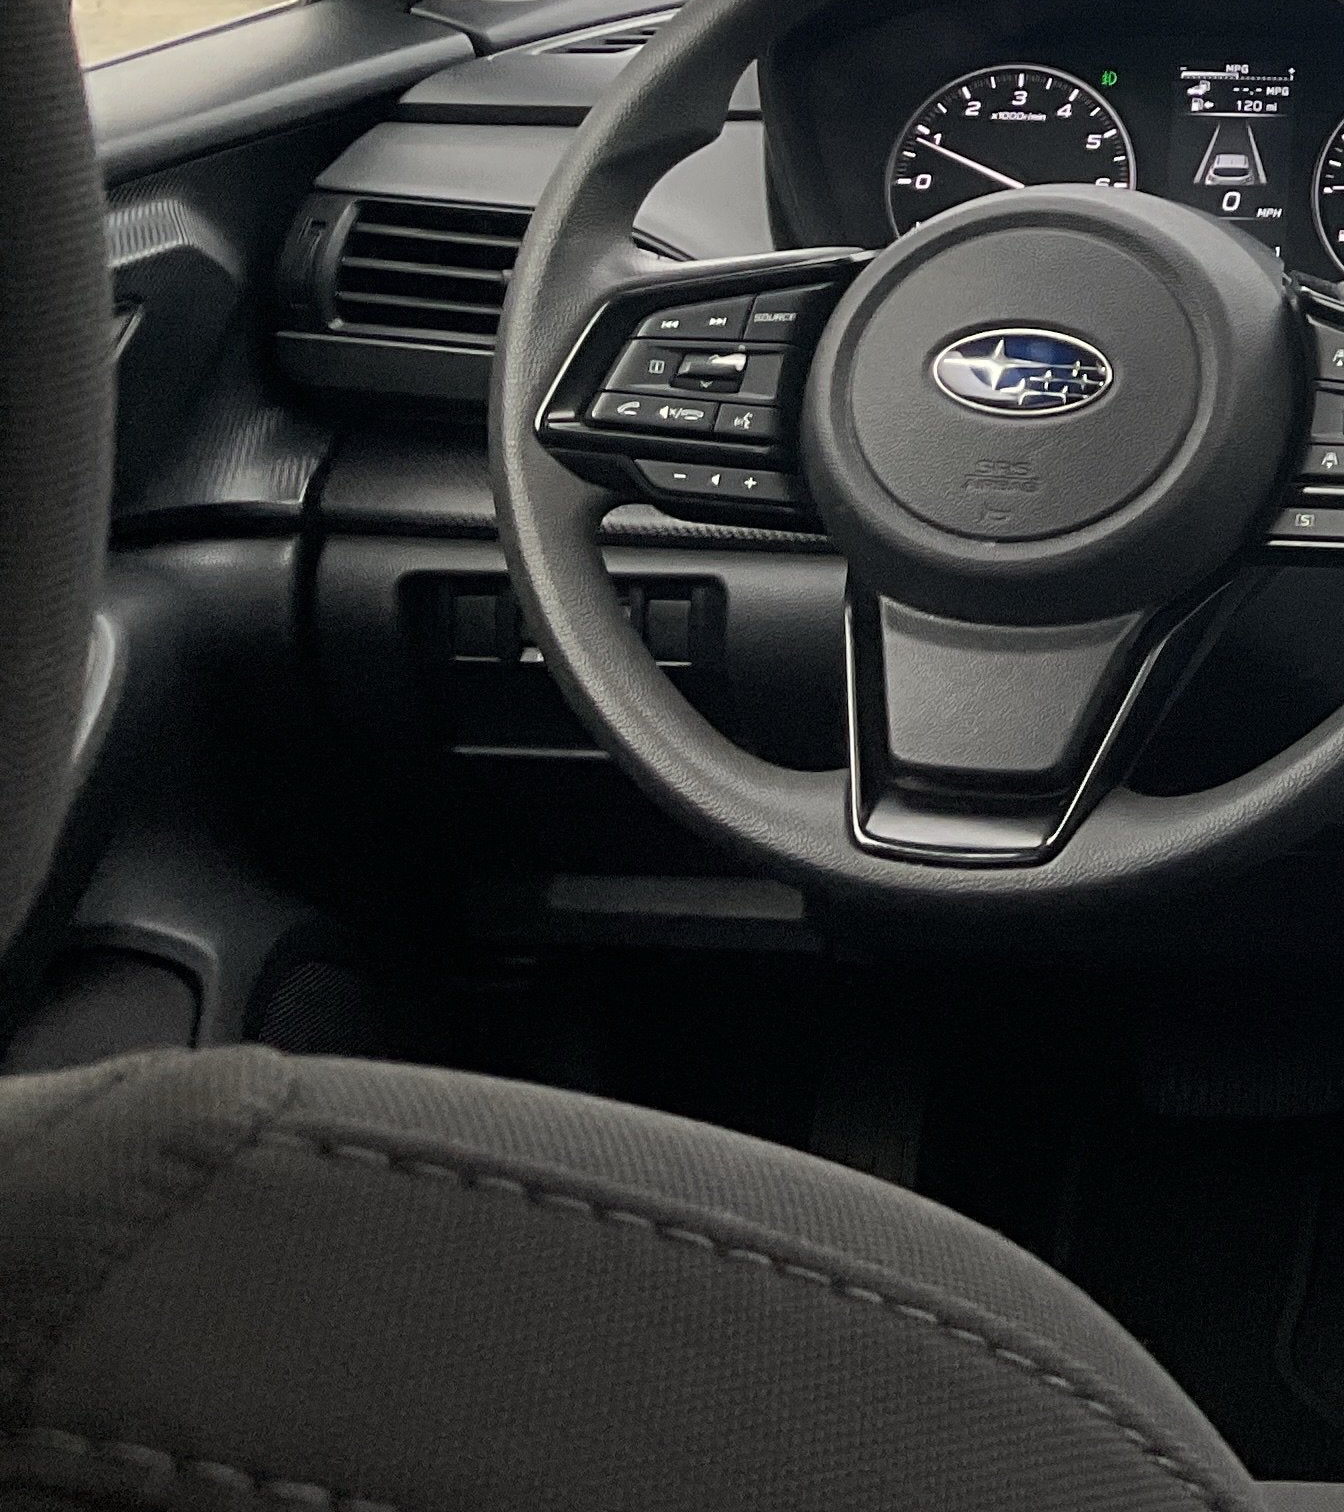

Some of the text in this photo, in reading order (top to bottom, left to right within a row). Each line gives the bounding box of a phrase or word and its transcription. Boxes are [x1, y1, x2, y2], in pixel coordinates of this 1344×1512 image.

[1225, 64, 1249, 74] MPG
[1011, 90, 1028, 105] 3
[1266, 86, 1289, 96] MPG
[964, 101, 981, 116] 2
[1056, 104, 1073, 118] 4
[1236, 100, 1278, 112] 120 mi
[933, 133, 942, 145] 1
[1086, 134, 1102, 150] 5
[915, 174, 932, 189] 0
[1222, 191, 1241, 211] 0
[1256, 207, 1283, 218] MPH
